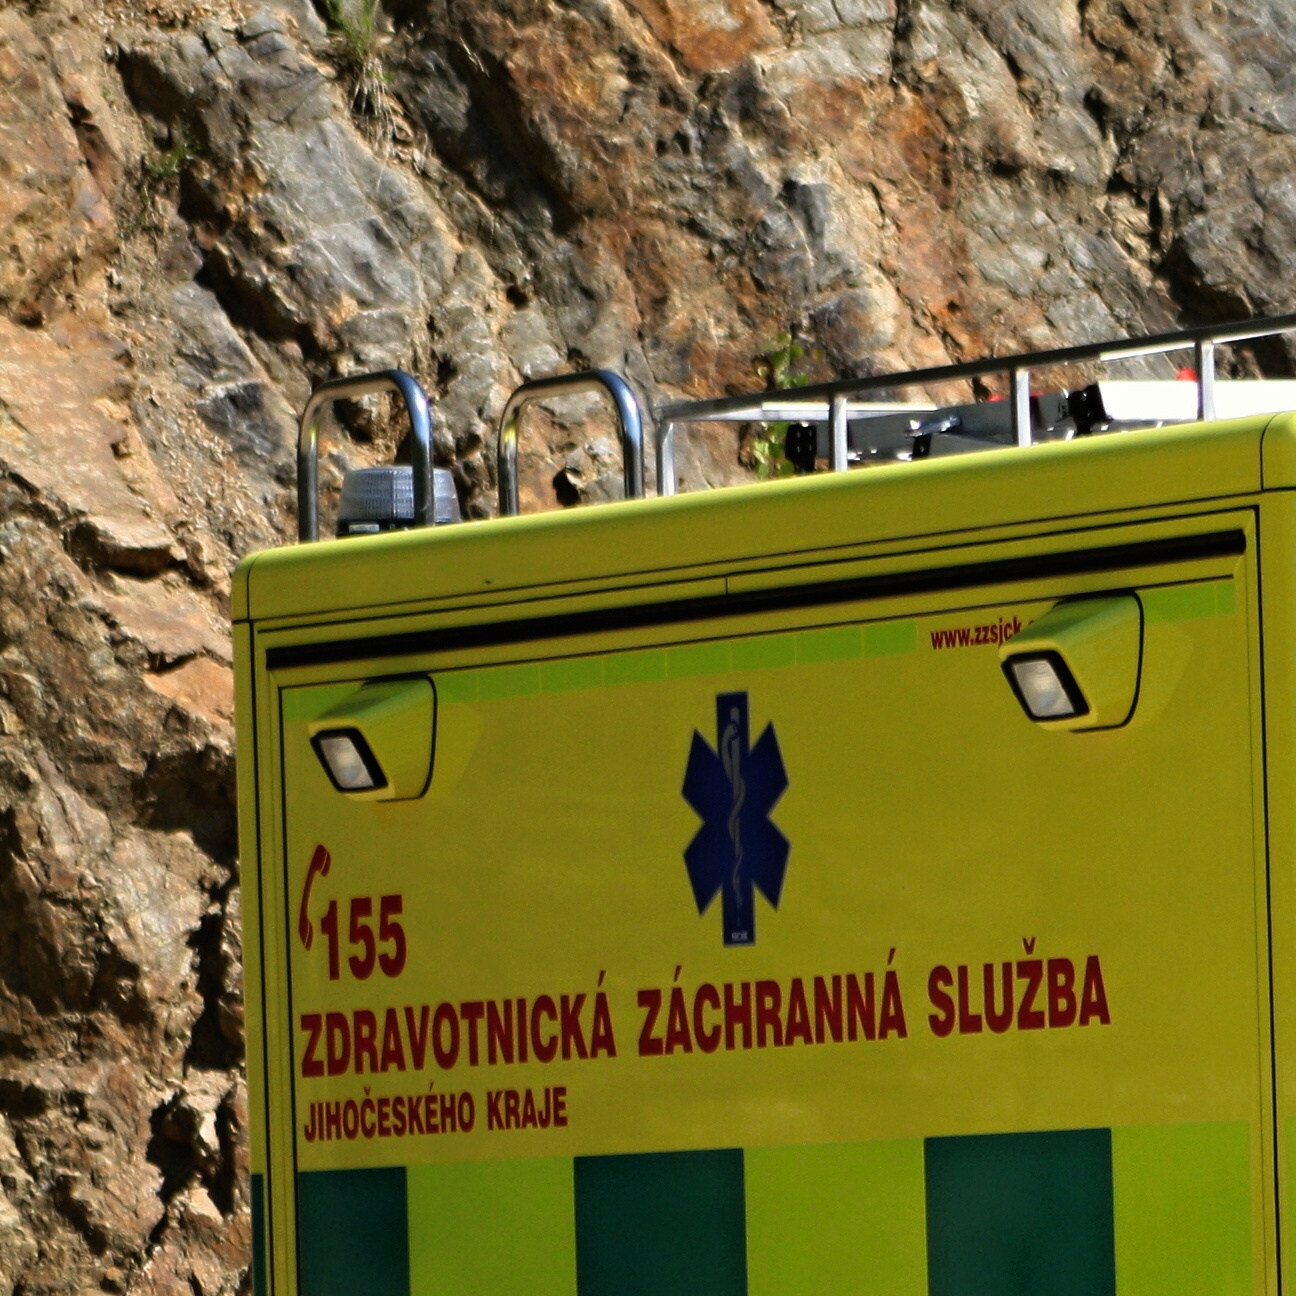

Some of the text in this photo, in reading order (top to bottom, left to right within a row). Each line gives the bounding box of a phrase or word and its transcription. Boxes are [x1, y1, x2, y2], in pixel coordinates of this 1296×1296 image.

[930, 616, 1035, 651] www.zzsjck
[320, 894, 408, 981] 155
[300, 936, 1112, 1079] ZDRAVOTNICKÁ ZÁCHRANNÁ SLUŽBA
[303, 1081, 569, 1143] JIHOČESKÉHO KRAJE
